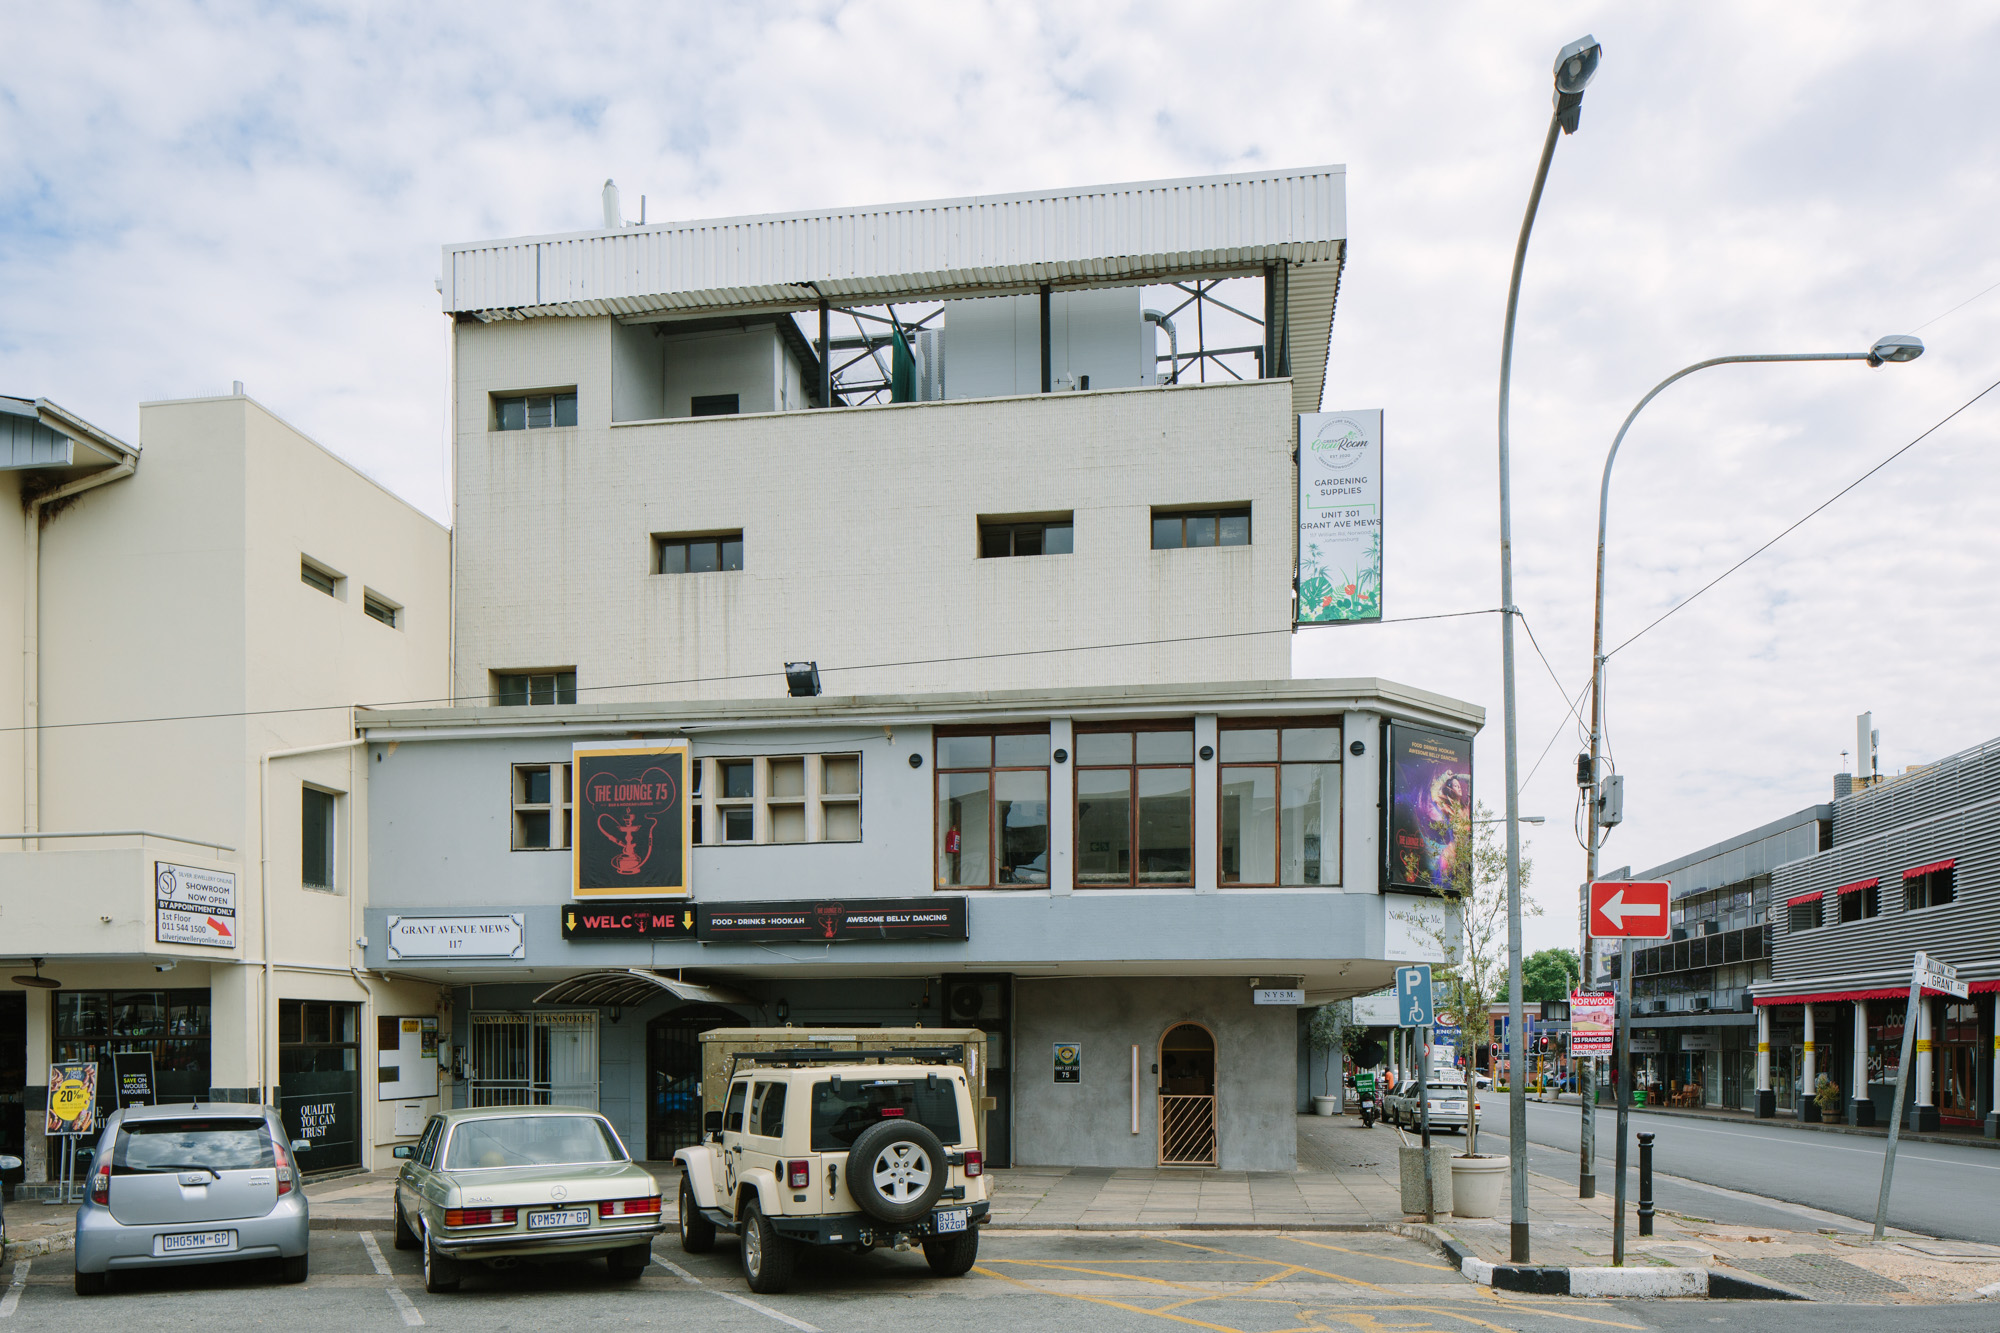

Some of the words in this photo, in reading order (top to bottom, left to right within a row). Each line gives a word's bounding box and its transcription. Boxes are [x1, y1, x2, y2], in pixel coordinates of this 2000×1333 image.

[1314, 476, 1368, 486] GARDENING
[1320, 486, 1362, 496] SUPPLIES
[1321, 510, 1342, 518] UNIT
[1345, 510, 1360, 518] 301
[1300, 522, 1331, 530] GRANT
[1334, 520, 1351, 528] AVE
[1354, 519, 1381, 527] MEWS
[1408, 748, 1428, 756] AWESOME
[1424, 744, 1438, 752] DRINKS
[594, 785, 612, 802] THE
[614, 784, 653, 801] LOUNGE
[656, 783, 668, 800] 75
[186, 882, 230, 894] SHOWROOM
[188, 894, 207, 902] NOW
[208, 896, 228, 904] OPEN
[160, 900, 168, 908] BY
[168, 902, 216, 914] APPOINTMENT
[216, 908, 234, 916] ONLY
[162, 912, 172, 920] 1st
[174, 914, 191, 922] Floor
[712, 918, 733, 926] FOOD
[738, 918, 766, 926] DRINKS
[912, 914, 948, 922] DANCING
[1406, 912, 1418, 922] You
[1419, 913, 1430, 922] See
[162, 922, 174, 930] 011
[176, 924, 188, 932] 544
[190, 925, 206, 934] 1500
[401, 925, 436, 934] GRANT
[438, 924, 476, 934] AVENUE
[479, 924, 510, 934] MEWS
[448, 940, 462, 948] 117
[1406, 971, 1422, 994] P
[1932, 975, 1954, 992] GRANT
[1957, 982, 1965, 992] AVE
[474, 1014, 499, 1023] GRANT
[300, 1103, 336, 1117] QUALITY
[300, 1116, 318, 1128] YOU
[318, 1114, 336, 1126] CAN
[300, 1126, 327, 1138] TRUST
[530, 1213, 568, 1226] KPM577
[576, 1211, 588, 1223] GP
[938, 1212, 954, 1222] BJ1
[214, 1232, 227, 1244] GP
